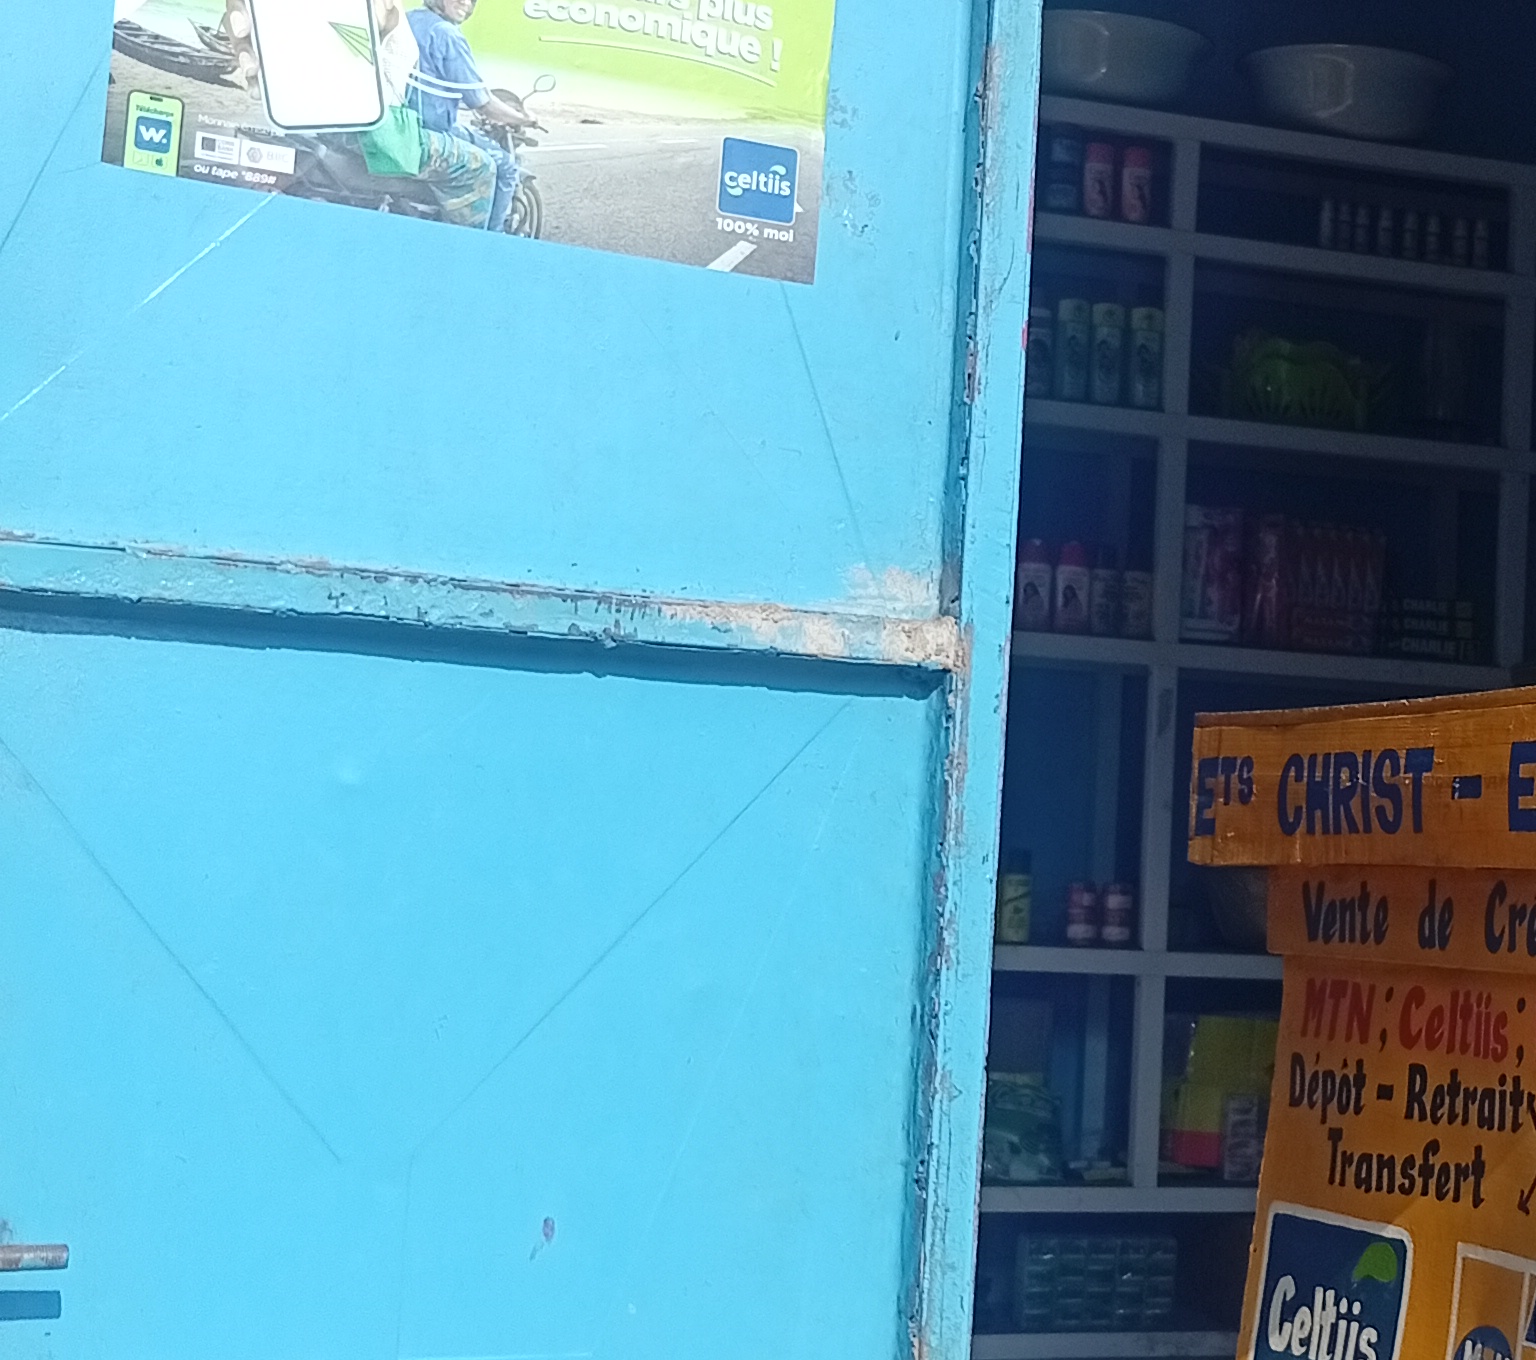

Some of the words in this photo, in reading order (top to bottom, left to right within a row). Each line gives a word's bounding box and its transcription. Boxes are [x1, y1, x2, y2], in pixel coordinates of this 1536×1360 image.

[193, 164, 210, 175] ou
[211, 166, 239, 180] tape
[724, 170, 792, 197] celtiis
[716, 217, 760, 237] 100%
[763, 227, 794, 243] moi
[1276, 747, 1435, 836] CHRIST
[1301, 880, 1389, 946] Vente
[1416, 879, 1454, 952] de
[1288, 1050, 1366, 1125] Dépôt
[1404, 1062, 1525, 1135] Retrait
[1327, 1126, 1486, 1210] Transfert
